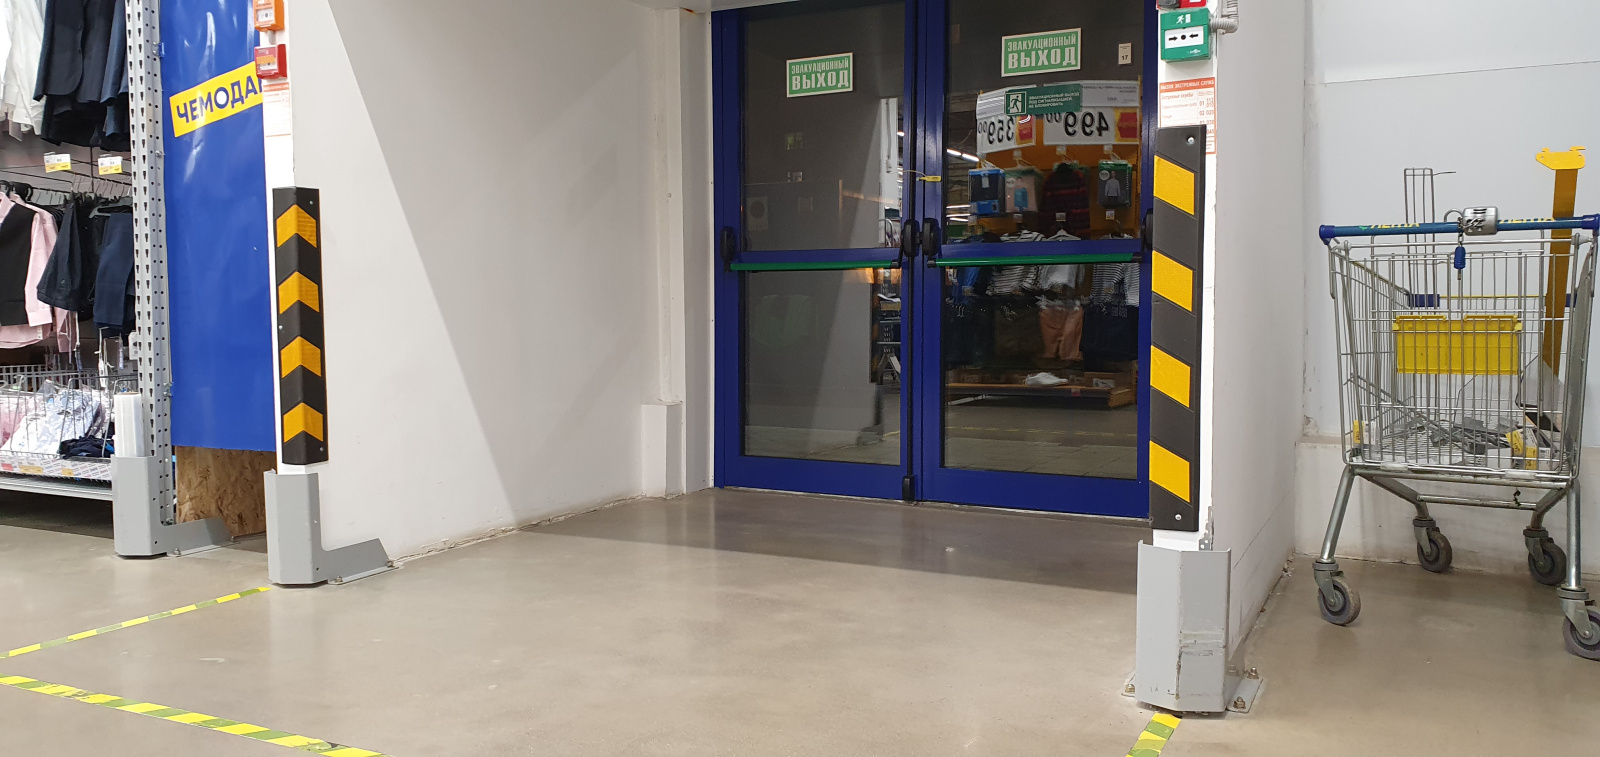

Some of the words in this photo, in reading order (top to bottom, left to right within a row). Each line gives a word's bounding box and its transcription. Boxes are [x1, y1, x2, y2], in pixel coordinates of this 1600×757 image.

[1007, 34, 1076, 51] ЭВАКУАЦИОННЫЙ
[791, 58, 849, 74] ЭВАКУАЦИОННЫЙ
[1008, 47, 1076, 69] ВЫХОД
[792, 70, 849, 91] ВЫХОД
